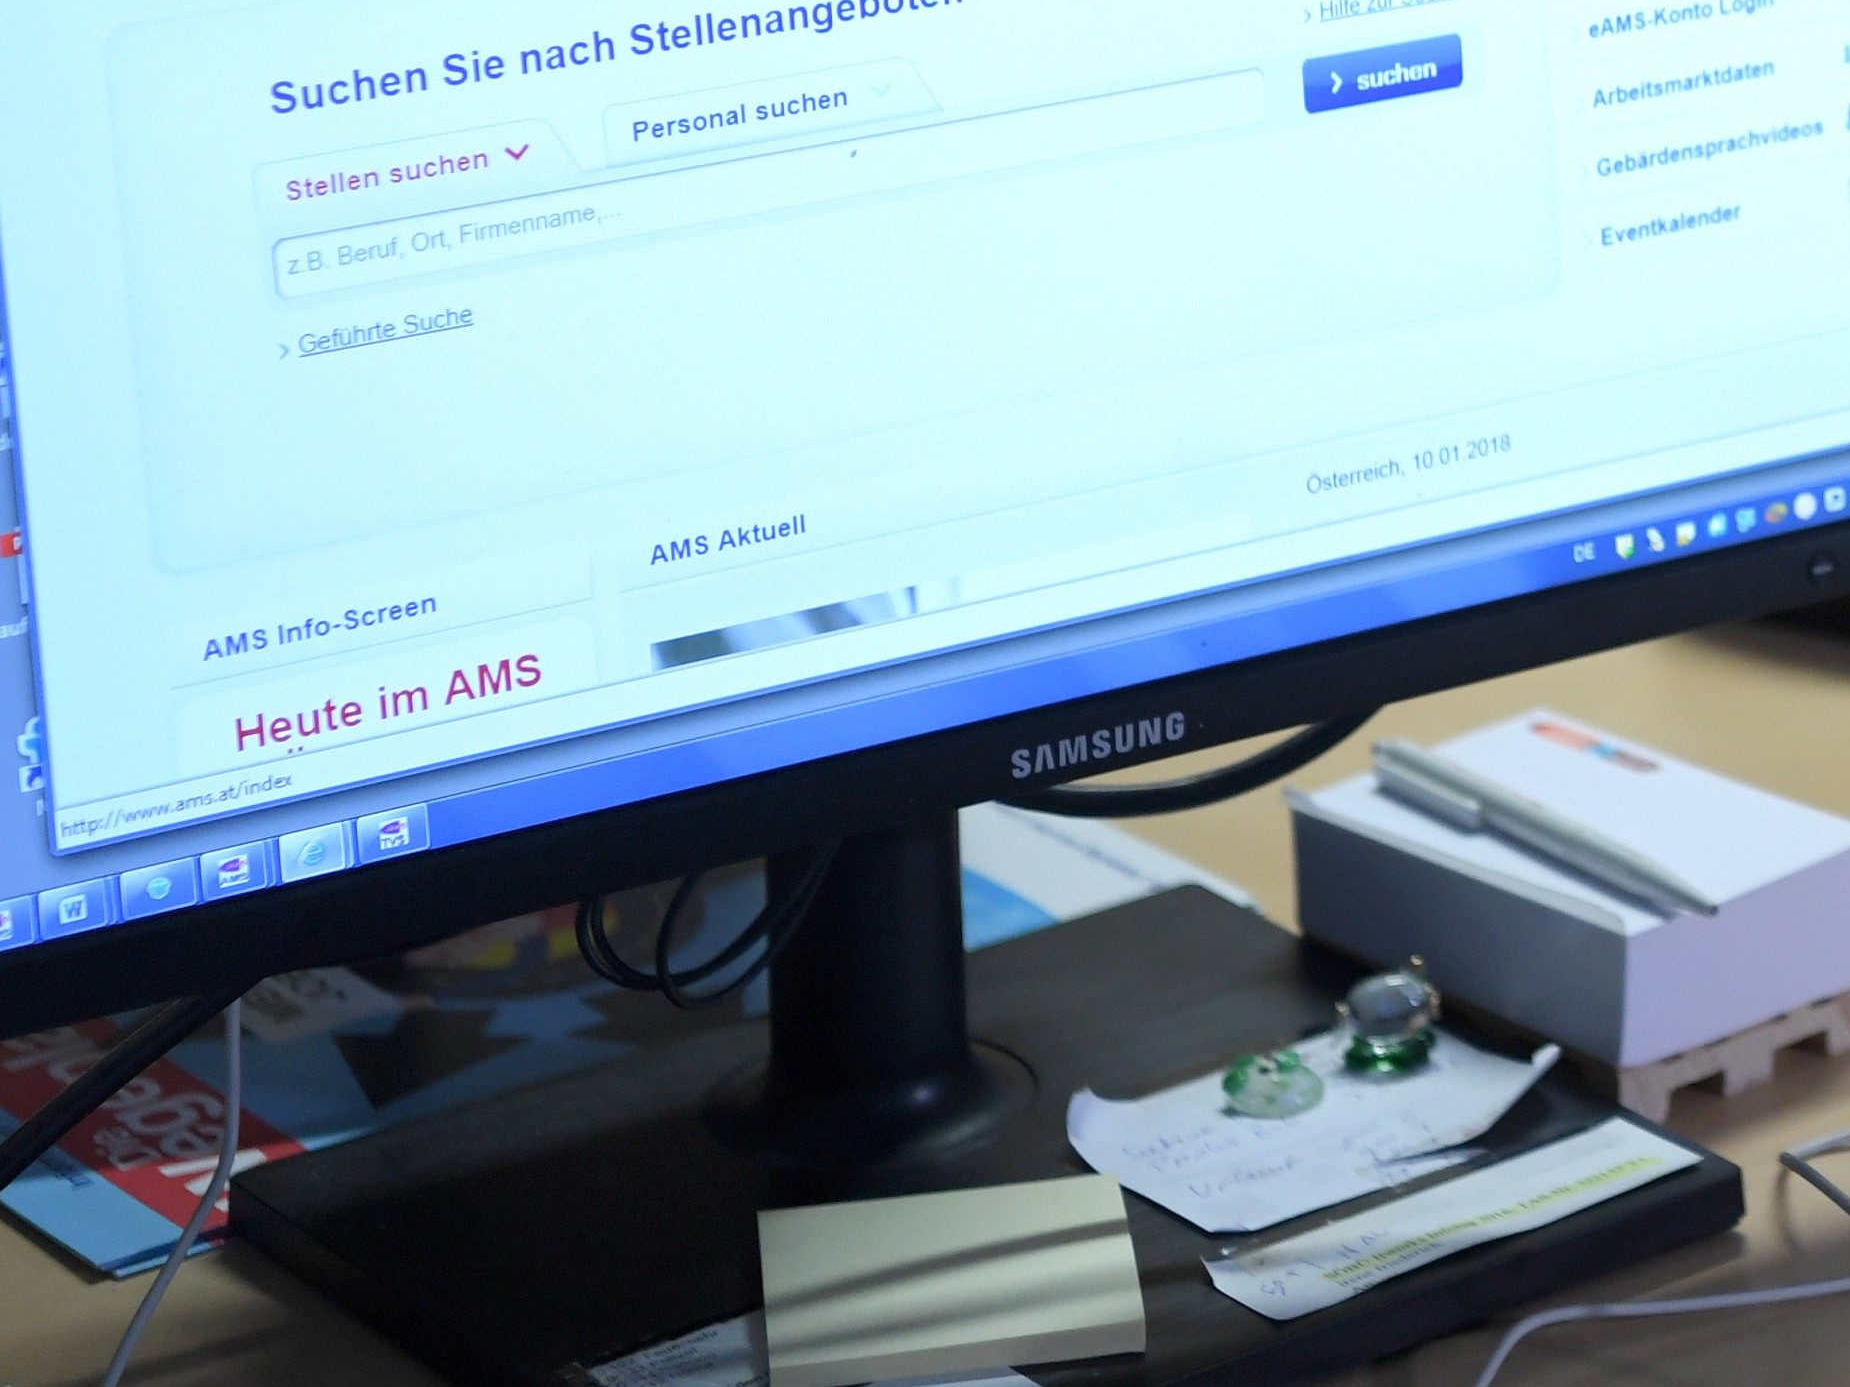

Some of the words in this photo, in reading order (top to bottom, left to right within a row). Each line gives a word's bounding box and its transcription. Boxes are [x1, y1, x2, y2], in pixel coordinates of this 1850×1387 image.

[1589, 2, 1713, 39] eAMS-Konto
[270, 62, 428, 115] Suchen
[442, 48, 507, 87] Sie
[519, 30, 617, 77] nach
[1356, 61, 1438, 92] suchen
[1593, 60, 1775, 108] Arbeitsmarktdaten
[285, 166, 381, 203] Stellen
[390, 148, 489, 184] suchen
[631, 103, 748, 143] Personal
[755, 87, 849, 122] suchen
[1597, 119, 1824, 178] Gebärdensprachvideos
[1601, 204, 1743, 248] Eventkalender
[298, 316, 397, 359] Geführte
[403, 305, 474, 340] Suche
[1306, 458, 1407, 494] Österreich,
[1413, 433, 1512, 471] 10.01.2018
[650, 534, 709, 566] AMS
[718, 513, 807, 553] Aktuell
[1573, 542, 1596, 563] DE
[203, 629, 268, 662] AMS
[278, 594, 437, 646] Info-Screen
[234, 696, 363, 752] Heute
[379, 684, 430, 722] im
[444, 653, 543, 707] AMS
[1010, 709, 1187, 780] SAMSUNG
[59, 773, 293, 840] http://www.ams.at/index
